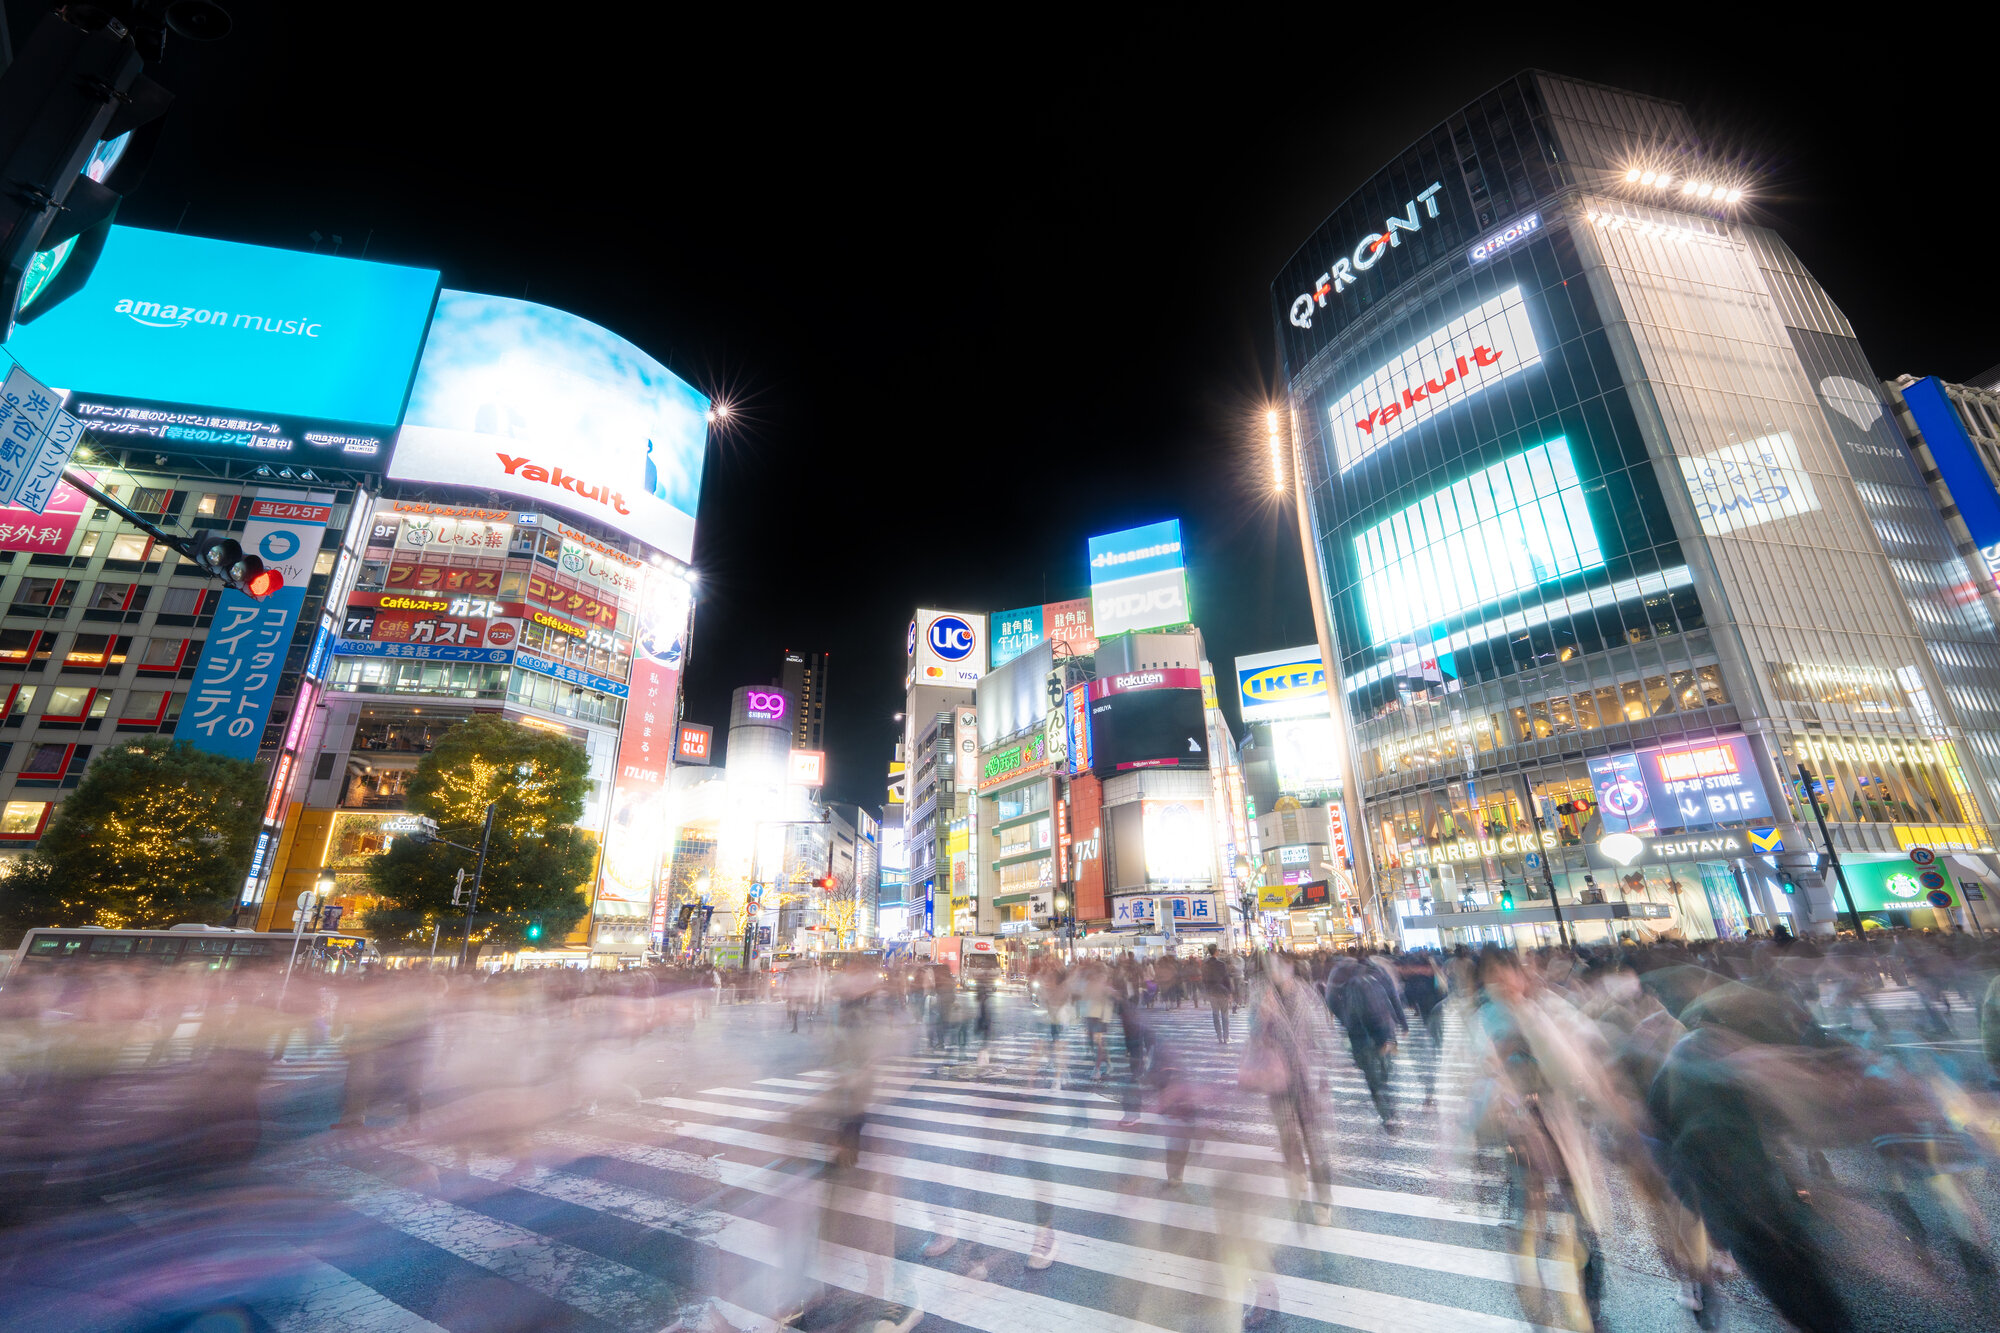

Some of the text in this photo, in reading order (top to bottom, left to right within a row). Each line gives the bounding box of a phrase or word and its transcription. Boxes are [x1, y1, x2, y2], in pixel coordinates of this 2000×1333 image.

[1473, 213, 1538, 260] QFRONT
[1290, 181, 1442, 330] QFRONT
[115, 298, 322, 338] amazon music
[1355, 344, 1503, 436] Yakult
[305, 432, 380, 448] amazon music
[1846, 441, 1905, 458] TSUTAYA
[22, 416, 76, 507] スクランブル式
[495, 452, 630, 516] Yakult
[258, 503, 323, 519] 当ビル5F
[393, 501, 510, 521] しゃぶしゃぶバイキング
[374, 525, 396, 538] 9F
[438, 527, 504, 549] しゃぶ葉
[389, 565, 498, 590] プライス
[449, 599, 504, 618] ガスト
[528, 577, 615, 623] コンタクト
[347, 618, 374, 633] 7F
[379, 619, 410, 632] Café
[1054, 608, 1087, 628] 龍角散
[409, 619, 479, 645] ガスト
[490, 631, 513, 640] ガスト
[586, 629, 626, 653] ガスト
[341, 641, 375, 653] AEON
[385, 643, 486, 660] 英会話イーオン
[194, 605, 260, 738] アイシティ
[227, 608, 288, 738] コンタクトの
[519, 655, 628, 695] AEON 英会話イーオン
[958, 671, 978, 680] VISA
[1116, 673, 1163, 689] Rakuten
[1251, 669, 1327, 695] IKEA
[748, 691, 785, 719] 109
[1047, 671, 1067, 758] もんじゃ
[1093, 704, 1112, 715] SHIBUYA
[640, 671, 660, 763] 私が、始まる。
[683, 742, 705, 755] QLO
[684, 730, 705, 745] UNI
[1794, 739, 1935, 764] STARBUCKS
[1665, 773, 1743, 795] POP-UP STORE
[1707, 790, 1755, 813] B1F
[1075, 826, 1100, 882] クスリ
[1404, 831, 1558, 867] STARBUCKS
[1653, 837, 1740, 857] TSUTAYA
[1883, 900, 1934, 909] STARBUCK
